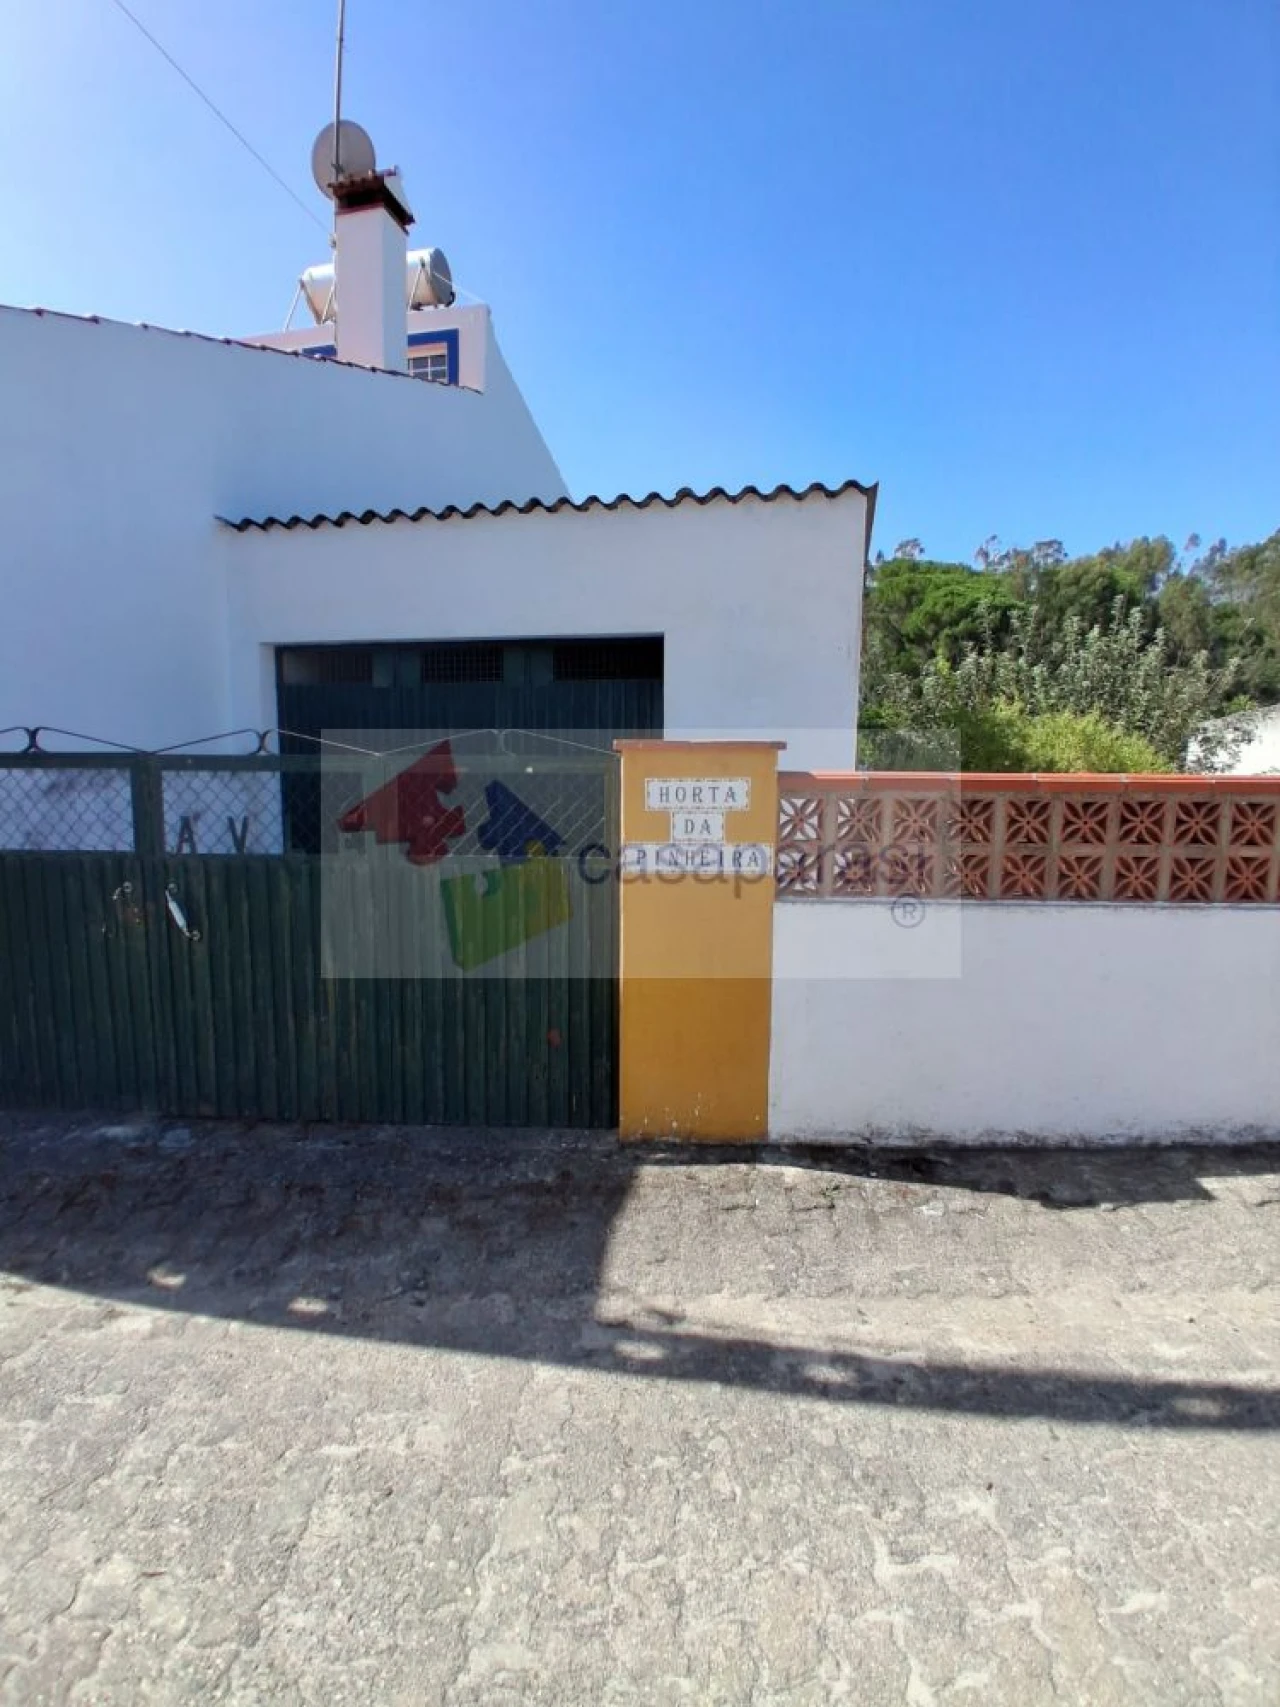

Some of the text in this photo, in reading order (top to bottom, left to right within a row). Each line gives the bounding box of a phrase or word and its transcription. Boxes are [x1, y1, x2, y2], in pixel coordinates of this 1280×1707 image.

[658, 786, 738, 804] HORTA
[684, 818, 712, 834] DA
[635, 848, 760, 867] PINHEIRA
